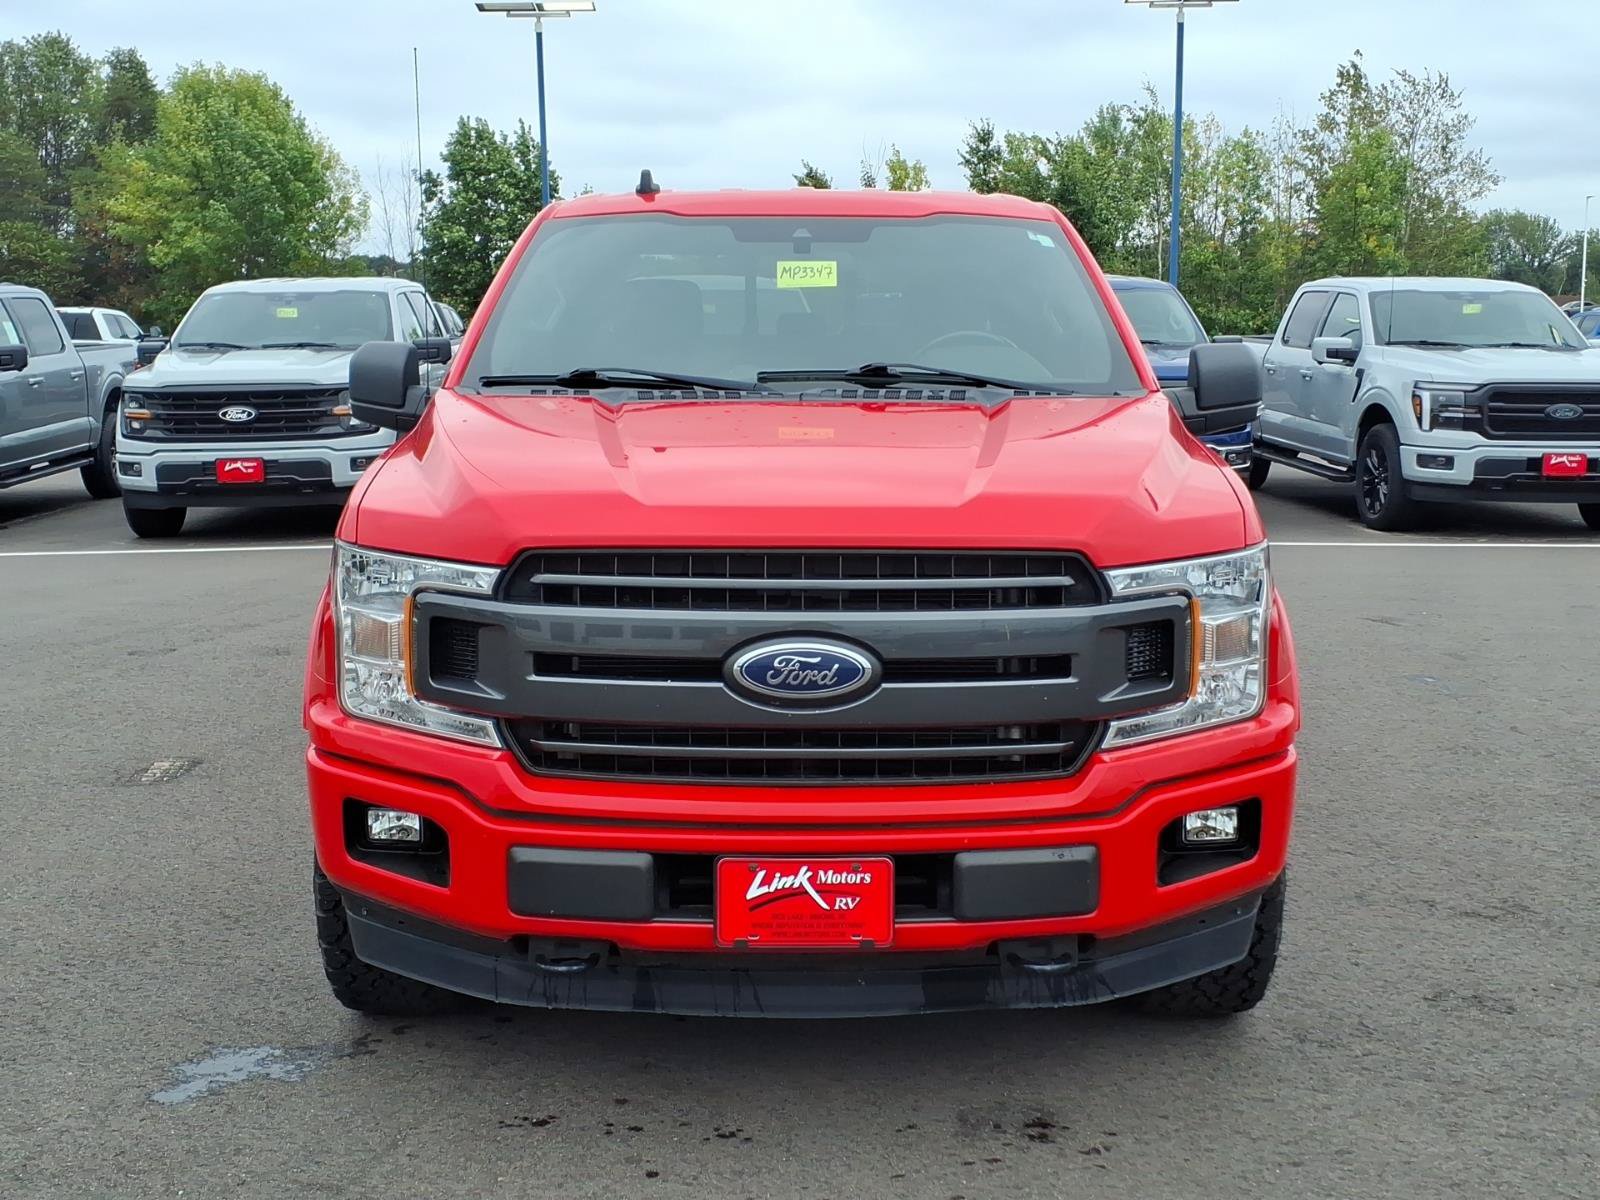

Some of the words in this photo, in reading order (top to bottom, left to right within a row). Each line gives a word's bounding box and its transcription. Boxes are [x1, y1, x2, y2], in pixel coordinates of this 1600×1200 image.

[780, 265, 833, 280] MP3347
[225, 409, 248, 419] Ford
[766, 655, 840, 685] Ford
[746, 866, 830, 910] Link
[816, 869, 872, 885] Motors
[833, 897, 861, 910] RV
